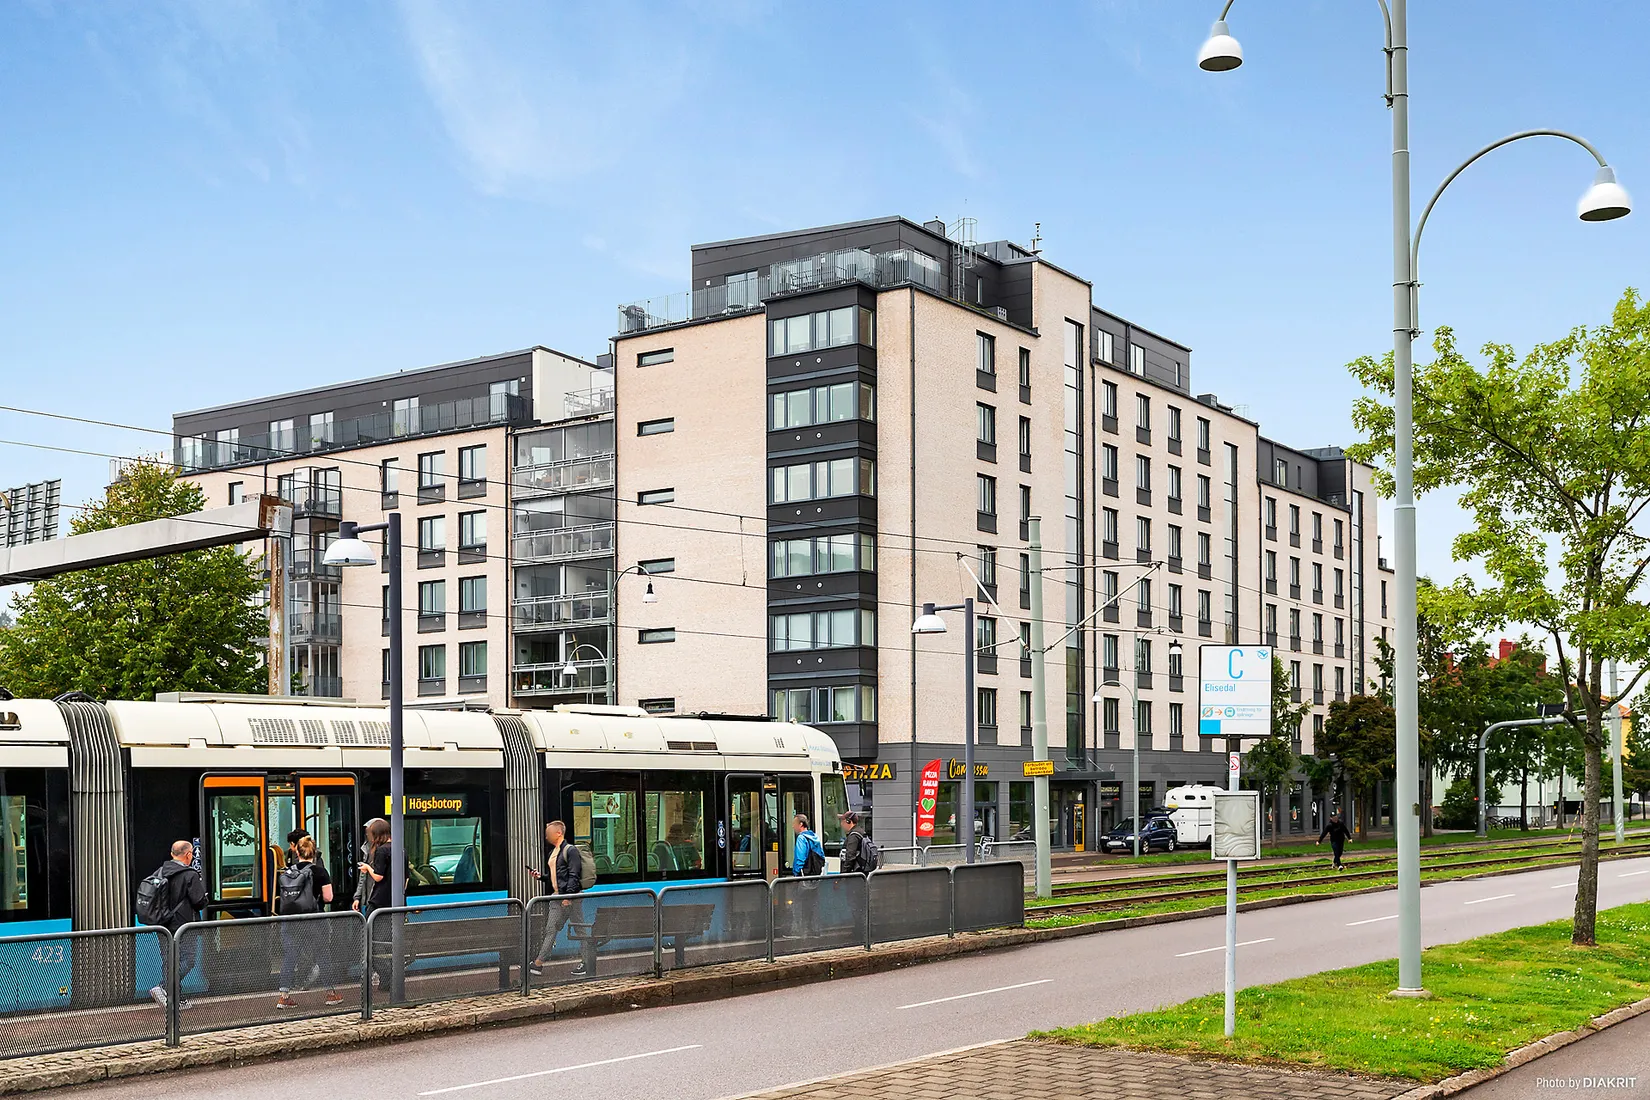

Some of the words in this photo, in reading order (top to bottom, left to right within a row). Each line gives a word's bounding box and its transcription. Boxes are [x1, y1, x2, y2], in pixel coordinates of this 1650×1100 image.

[1228, 648, 1244, 680] C
[1204, 683, 1236, 692] Elisedal
[843, 763, 893, 780] PIZZA
[409, 796, 462, 812] Högsbotorp
[31, 945, 63, 964] 423
